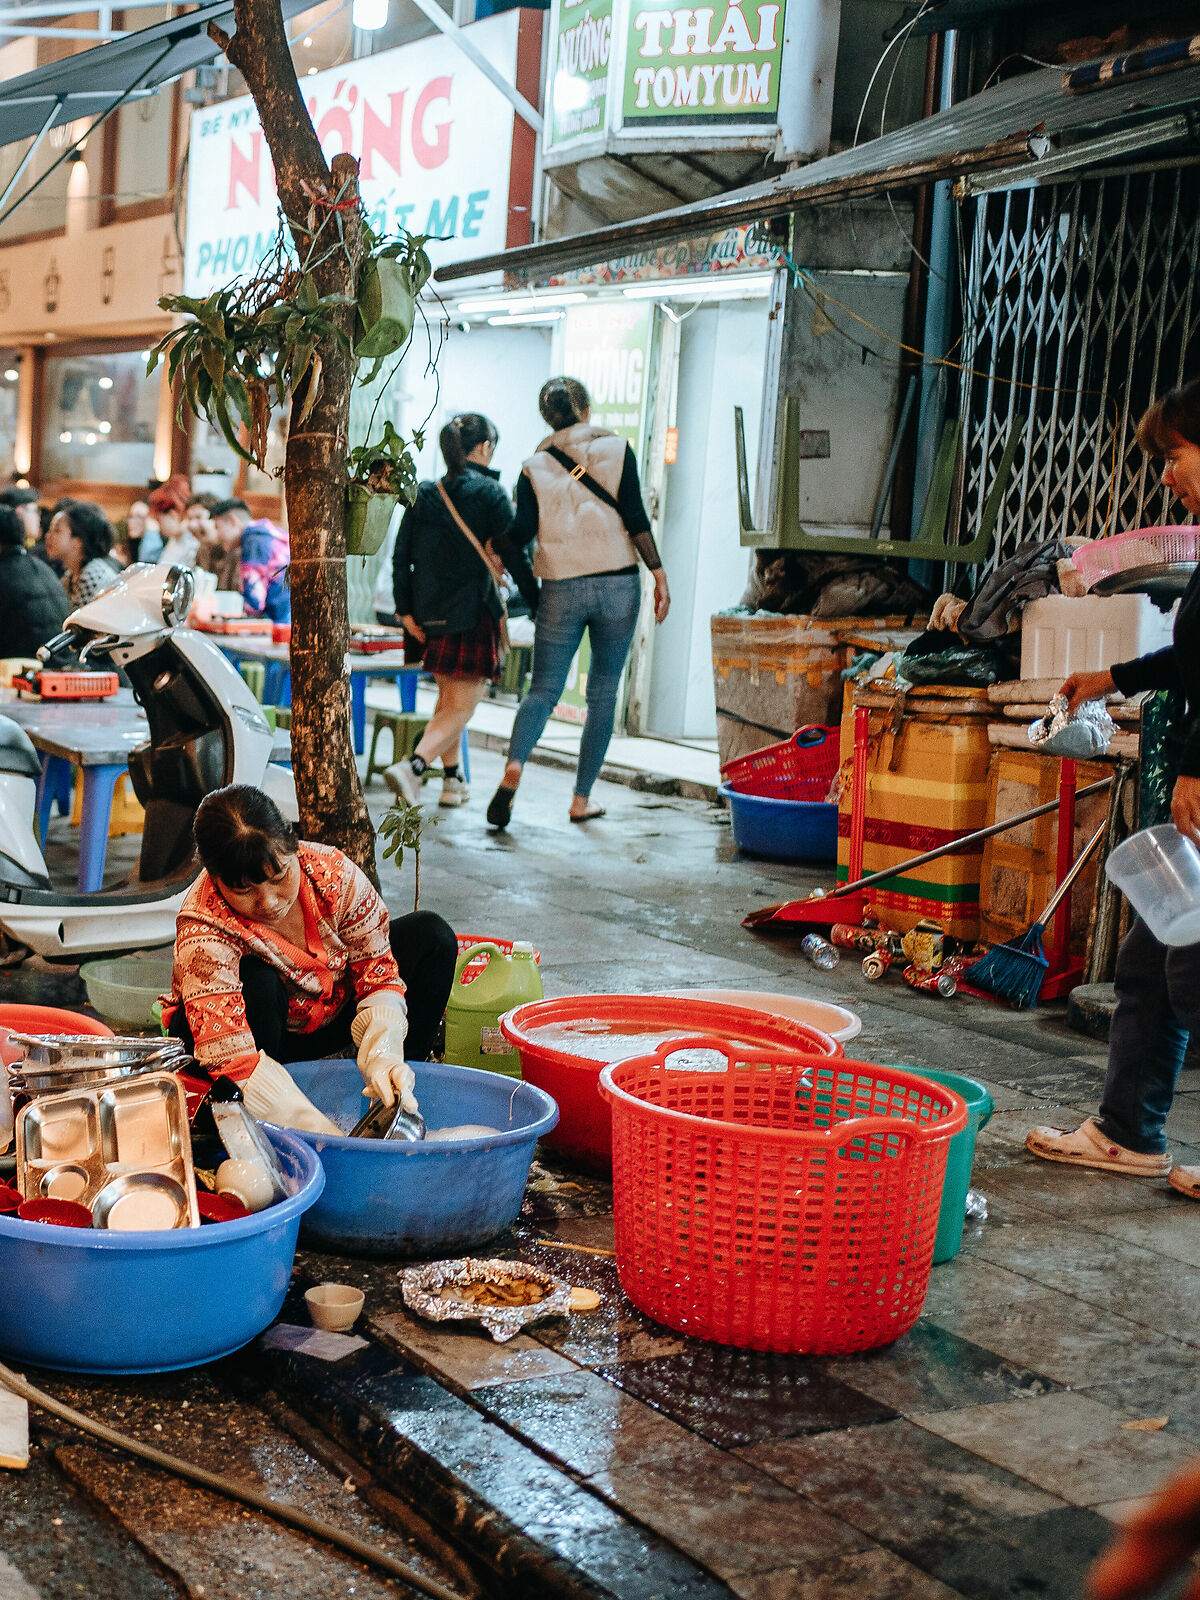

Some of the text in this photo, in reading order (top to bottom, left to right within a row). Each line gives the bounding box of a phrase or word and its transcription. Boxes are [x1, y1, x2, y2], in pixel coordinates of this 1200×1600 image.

[634, 0, 781, 56] THÁI
[633, 61, 773, 109] TOMYUM
[201, 114, 222, 137] BÉ
[226, 73, 455, 211] NỚNG
[366, 187, 416, 238] ỐT
[425, 189, 491, 240] ME
